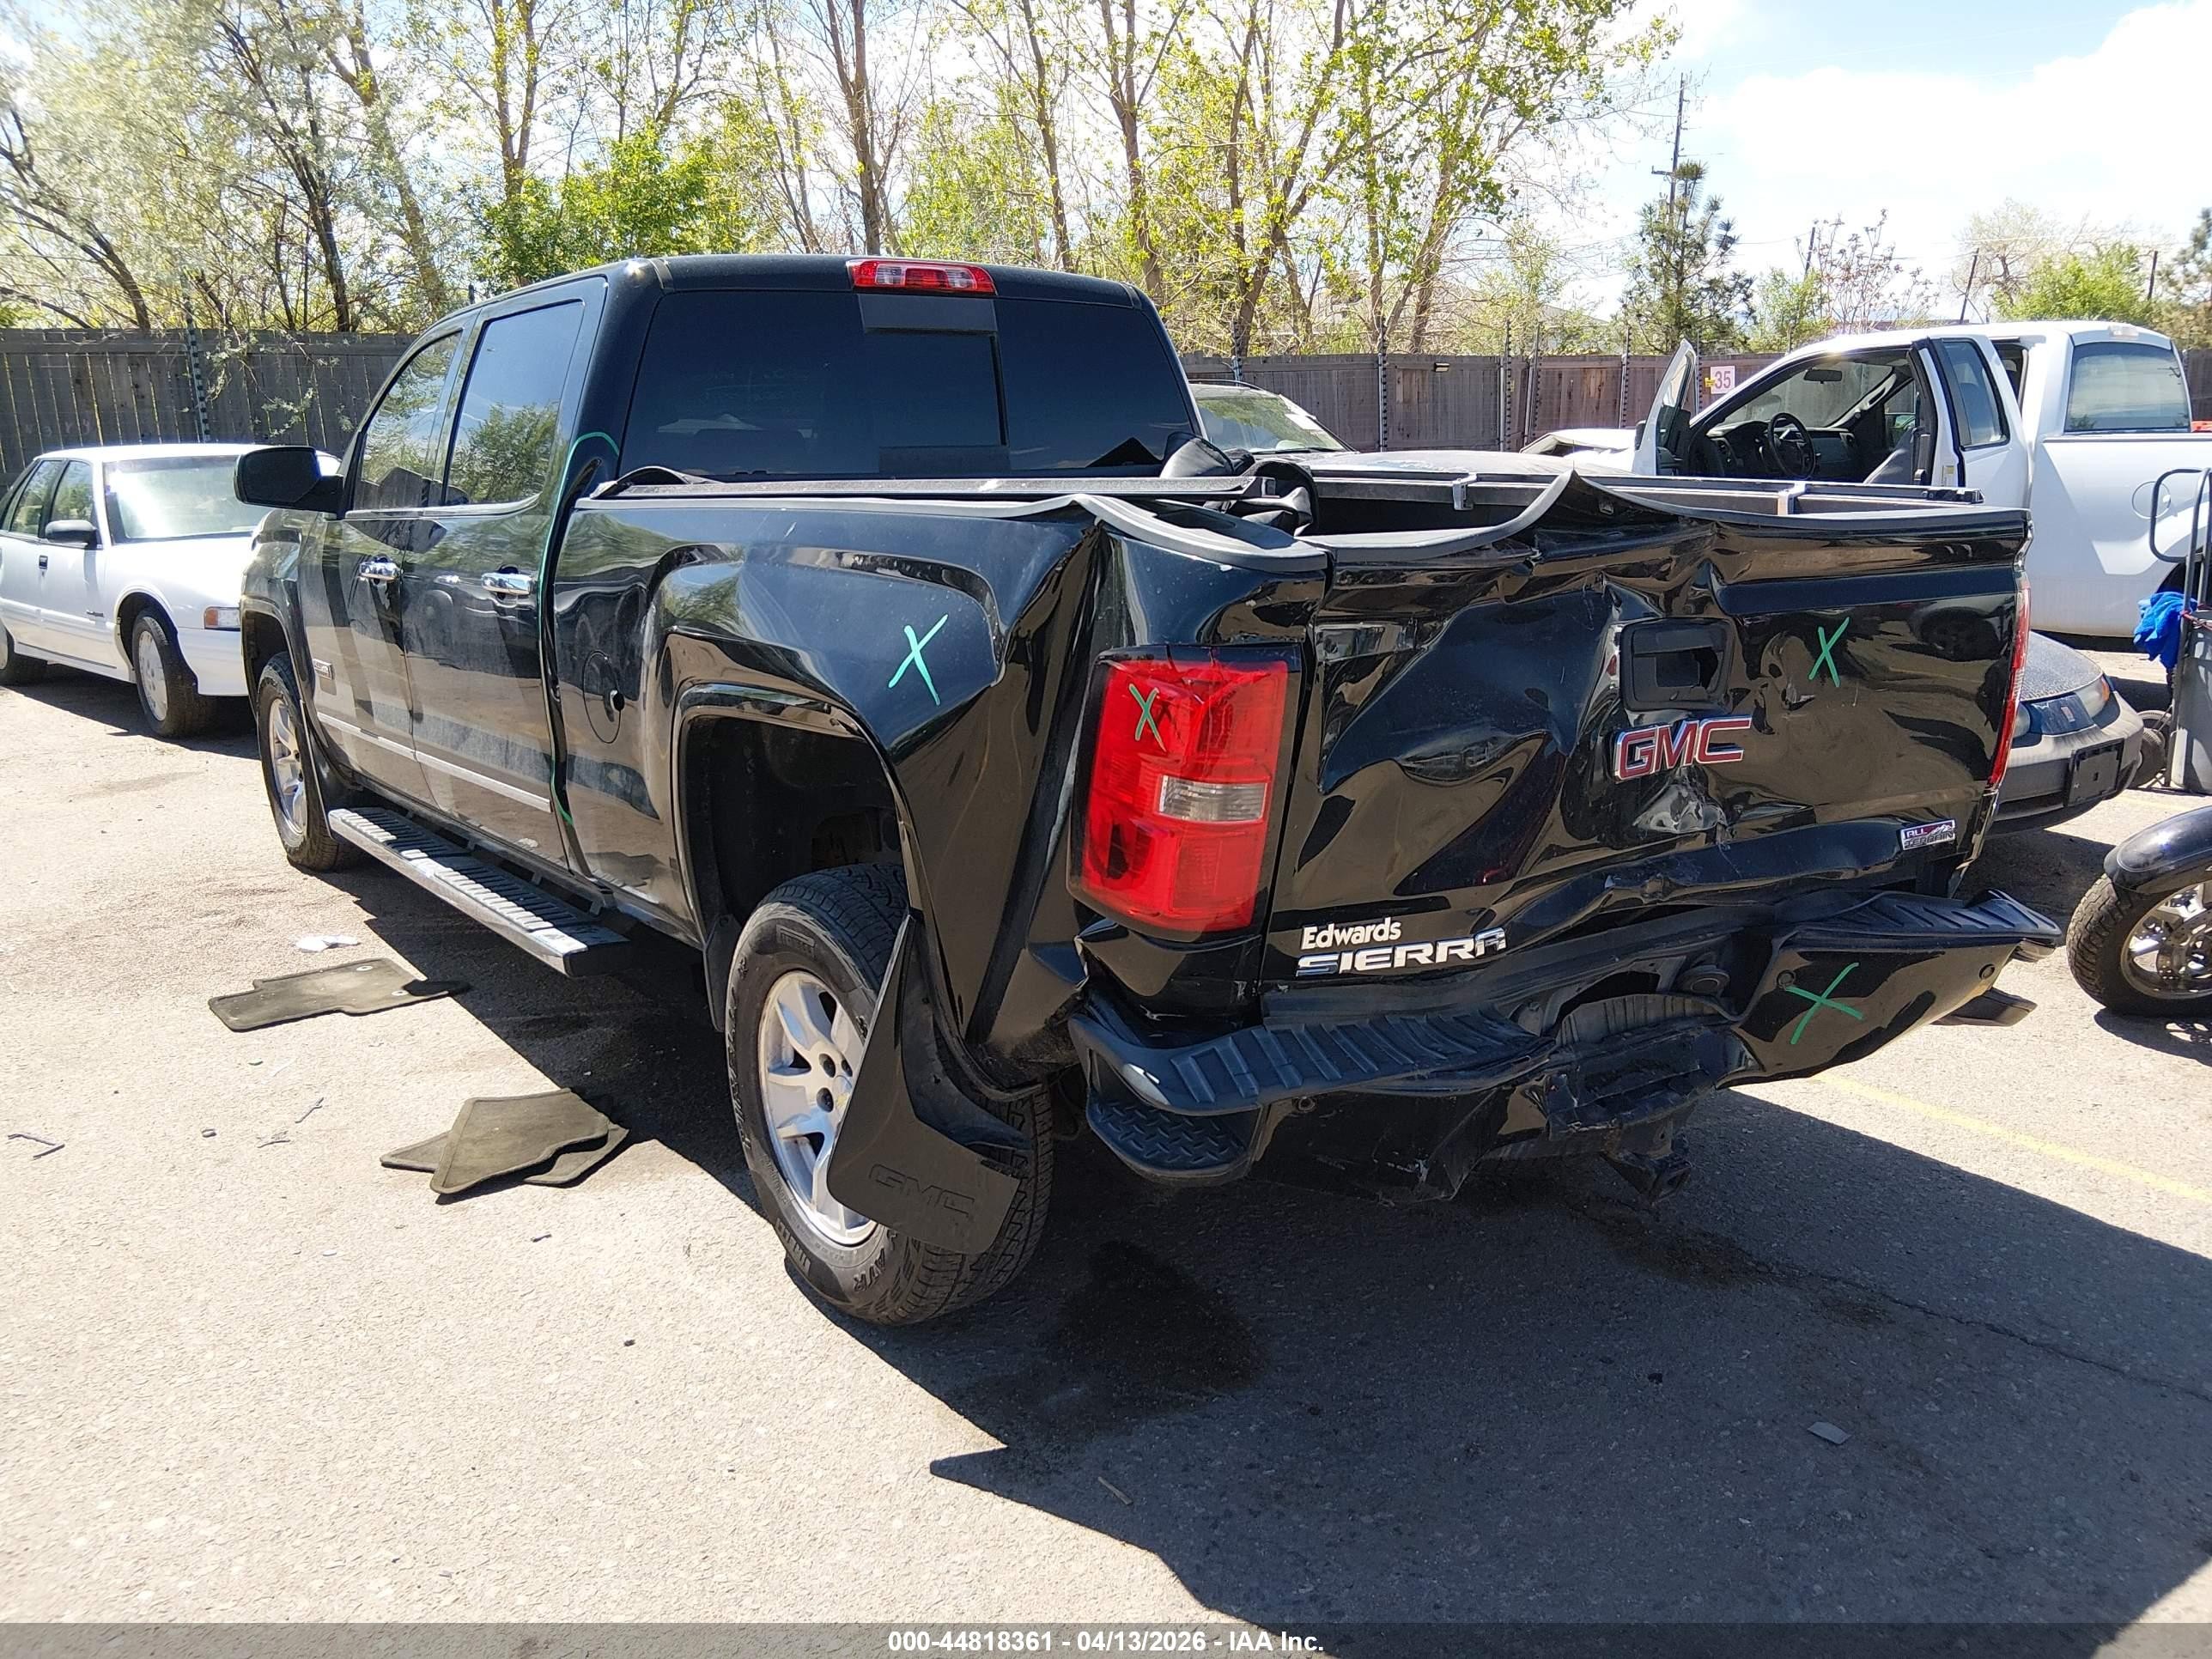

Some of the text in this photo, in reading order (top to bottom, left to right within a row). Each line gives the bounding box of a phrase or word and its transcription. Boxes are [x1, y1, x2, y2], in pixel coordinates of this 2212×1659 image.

[1714, 370, 1731, 389] 35
[1613, 714, 1753, 783] GMC
[1295, 927, 1508, 977] SIERRA
[1301, 916, 1401, 950] Edwards
[868, 1163, 975, 1218] GMC
